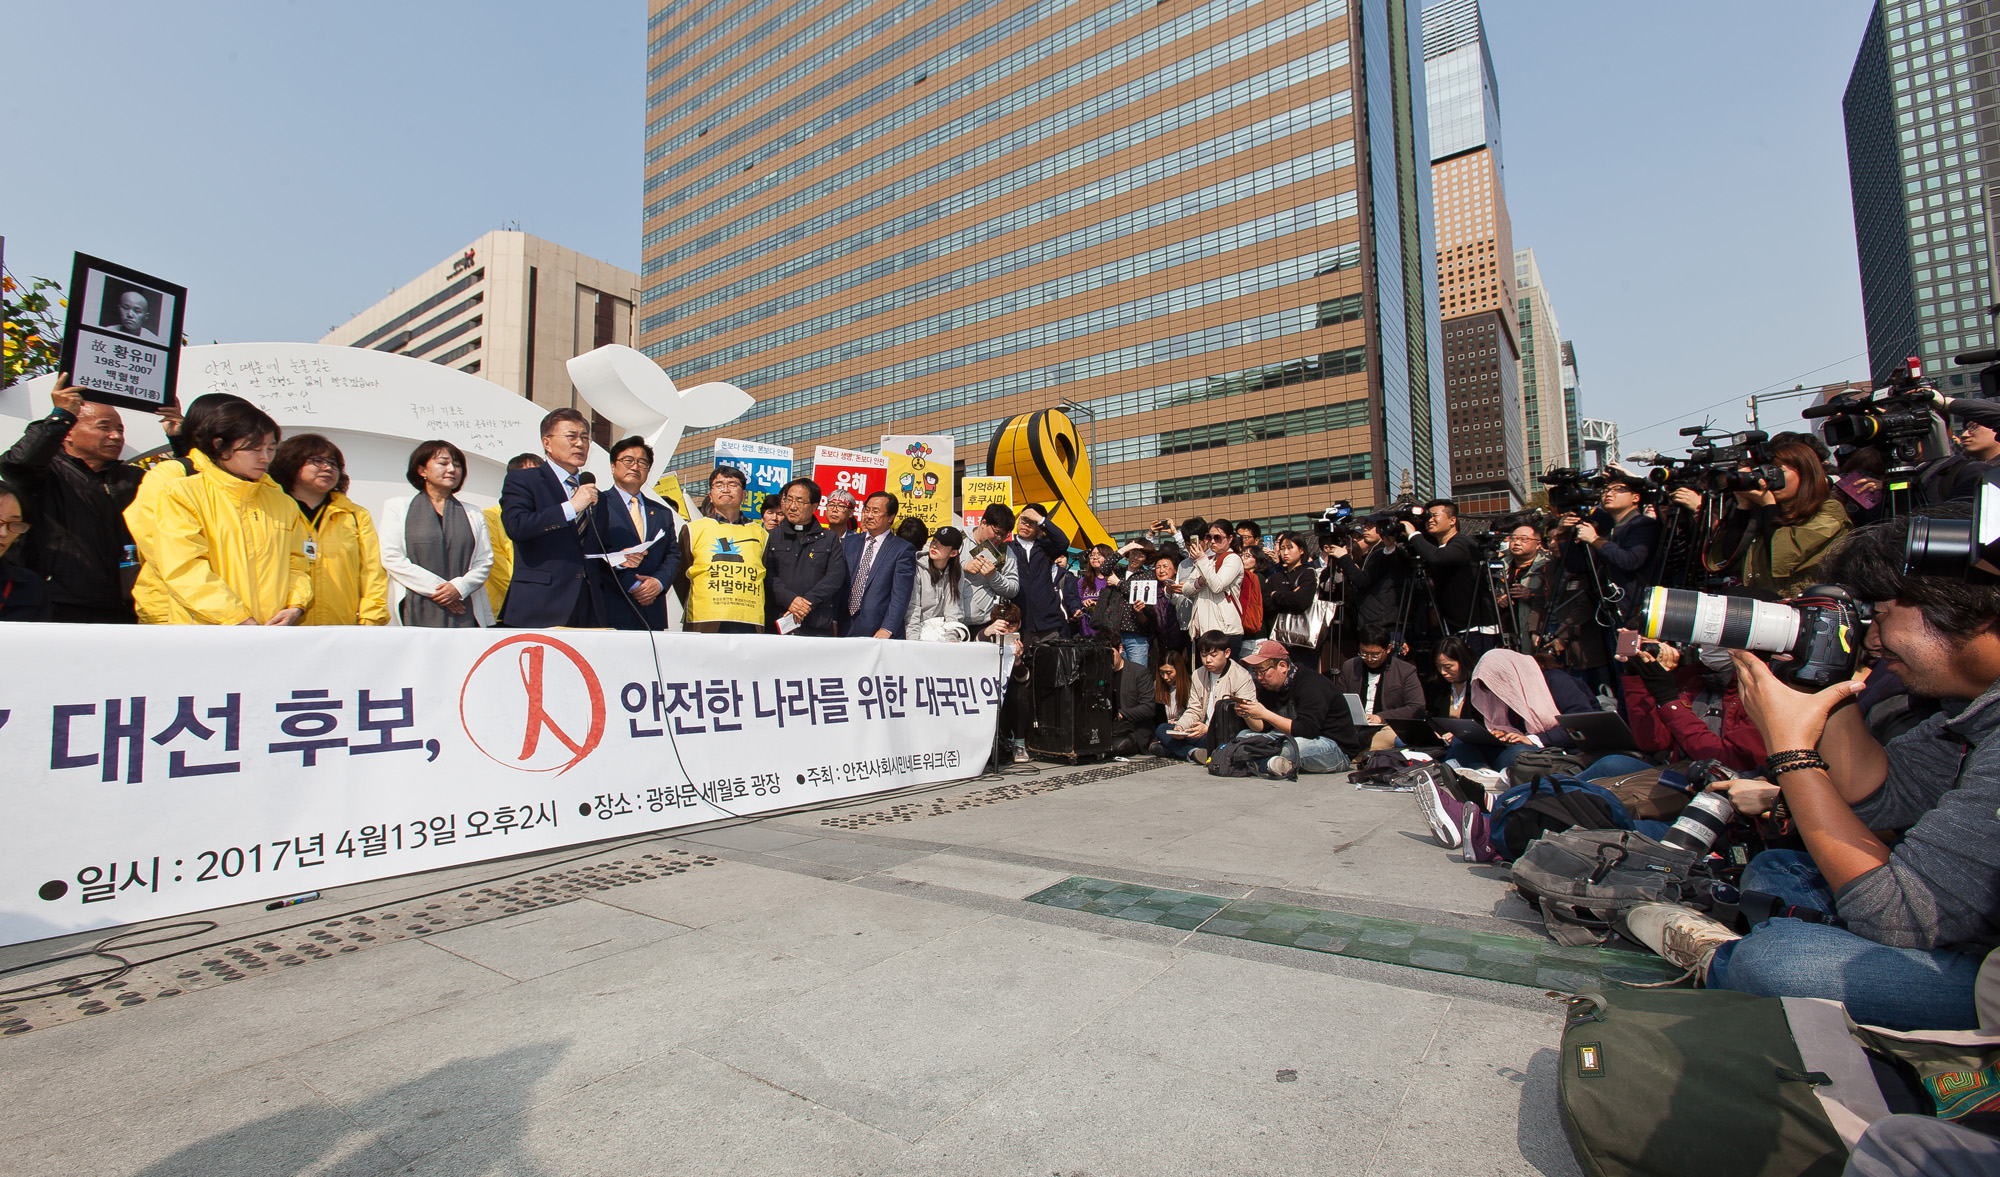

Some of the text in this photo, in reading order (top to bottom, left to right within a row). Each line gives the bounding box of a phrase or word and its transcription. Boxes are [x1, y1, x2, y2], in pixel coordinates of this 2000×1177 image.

[91, 339, 157, 367] 故 황유미
[94, 355, 153, 375] 1985~2007
[79, 375, 161, 400] 삼성반도체(기흥)
[720, 441, 740, 451] 돈보다
[821, 449, 840, 459] 돈보다
[855, 454, 873, 465] 돈보다
[755, 464, 789, 488] 산재
[834, 470, 868, 495] 유해
[967, 482, 1006, 492] 기억하자
[899, 499, 938, 513] 잘가라!
[967, 494, 1006, 506] 후쿠시마
[707, 564, 758, 582] 살인기업
[707, 579, 760, 597] 처벌하라!
[50, 692, 241, 785] 대선
[268, 687, 441, 768] 후보,
[620, 680, 743, 739] 안전한
[752, 677, 849, 729] 나라를
[857, 675, 908, 721] 위한
[915, 676, 980, 717] 대국민
[807, 765, 834, 788] 주최
[594, 792, 633, 821] 장소
[646, 783, 698, 813] 광화문
[702, 777, 749, 806] 세월호
[751, 772, 781, 797] 광장
[76, 856, 160, 904] 일시
[195, 832, 325, 882] 2017년
[334, 815, 456, 860] 4월13일
[465, 800, 557, 838] 오후2시
